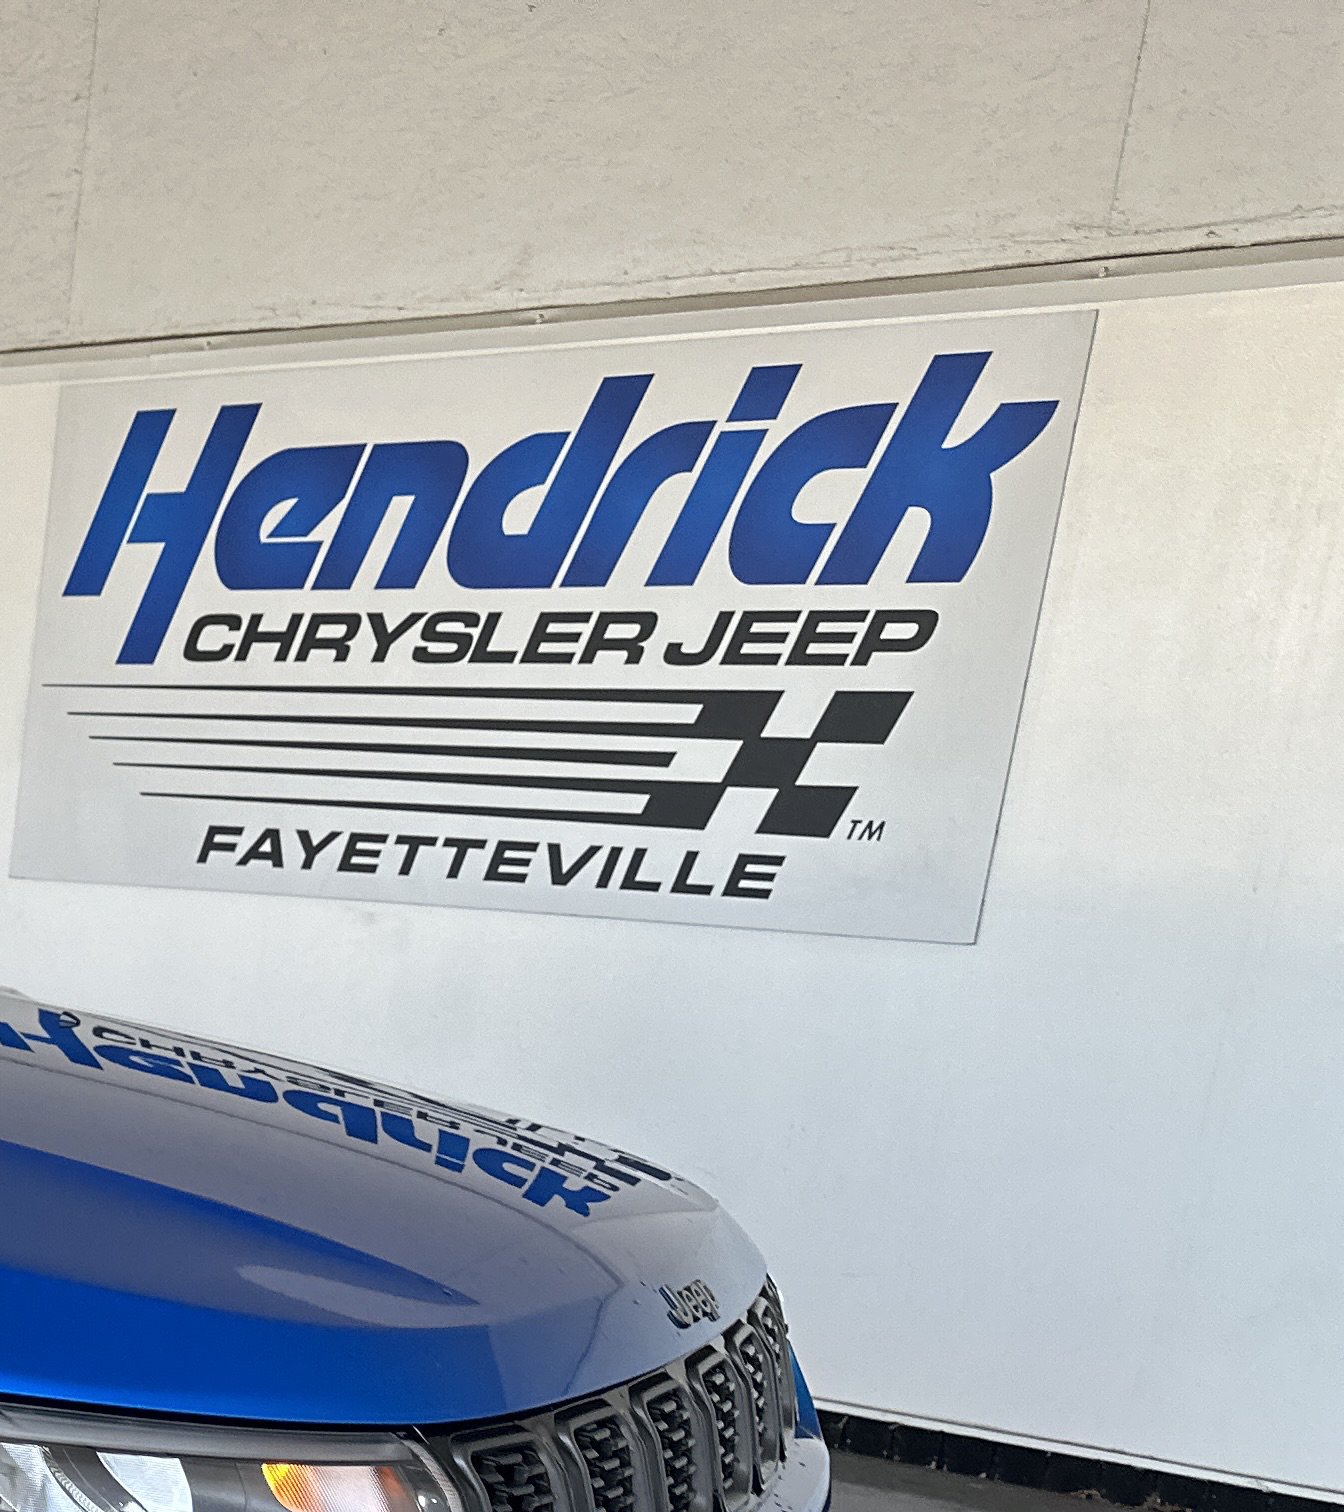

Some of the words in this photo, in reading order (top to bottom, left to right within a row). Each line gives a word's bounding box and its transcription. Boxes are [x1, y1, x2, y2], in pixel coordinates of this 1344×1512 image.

[62, 351, 1059, 664] Hendrick
[182, 610, 653, 665] CHRYSLER
[661, 609, 939, 666] JEEP
[847, 820, 886, 841] TM
[195, 825, 786, 900] FAYETTEVILLE
[658, 1279, 720, 1329] Jeep
